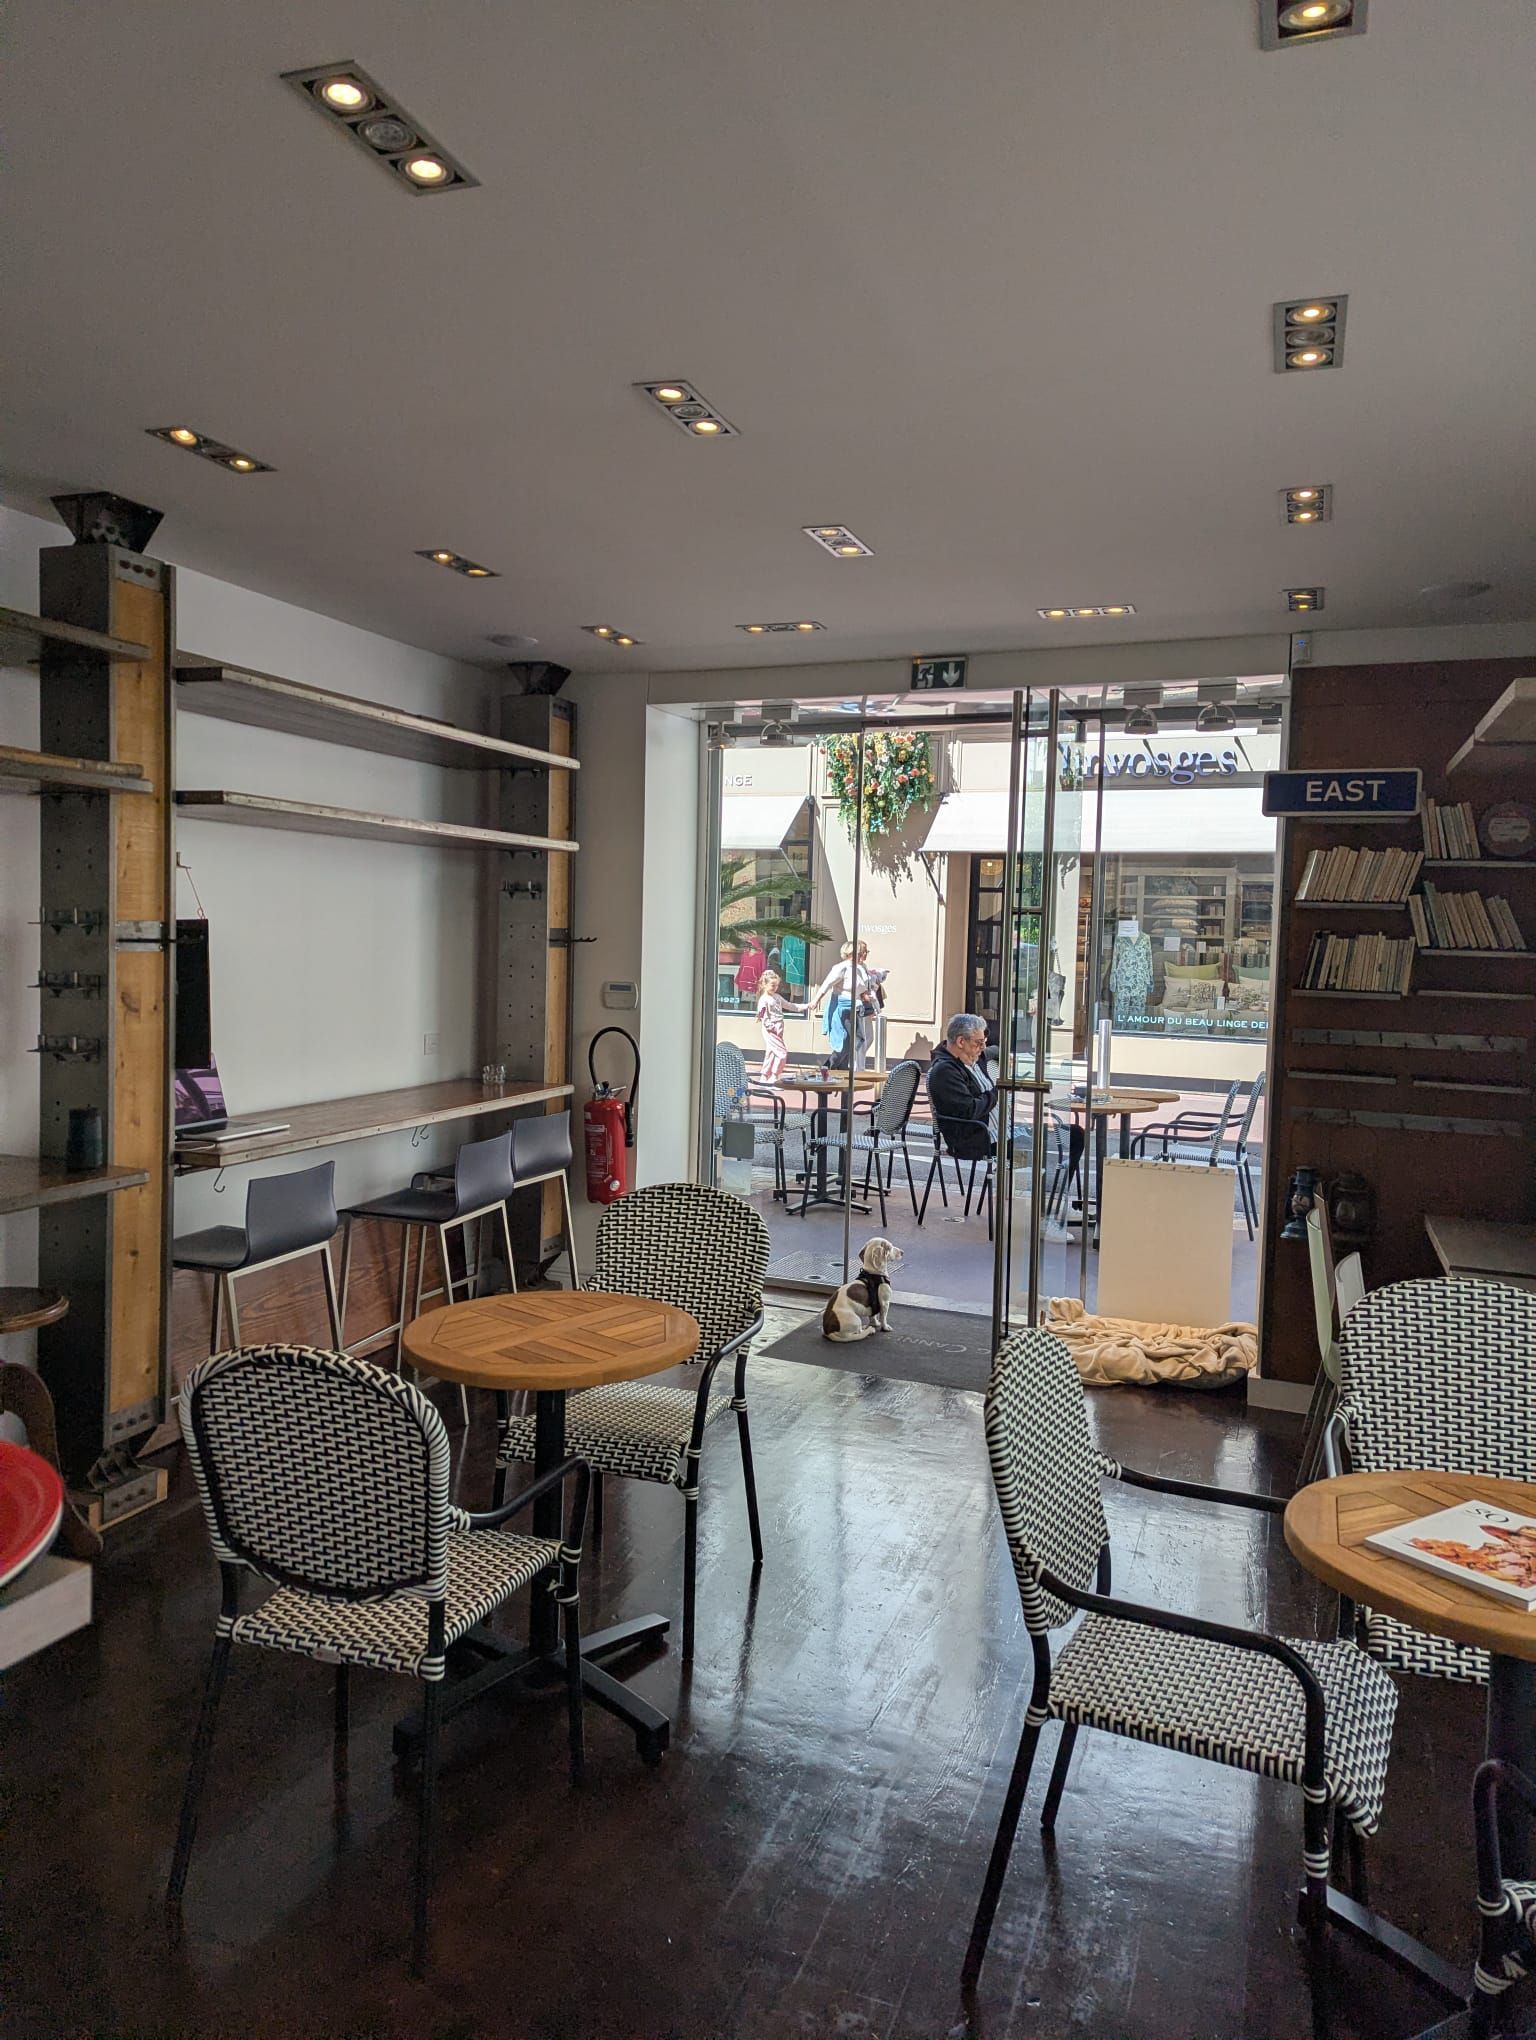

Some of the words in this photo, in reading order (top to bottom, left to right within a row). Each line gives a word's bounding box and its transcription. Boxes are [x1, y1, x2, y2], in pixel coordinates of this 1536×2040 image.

[1306, 779, 1386, 802] EAST
[1167, 1017, 1182, 1025] DU
[1185, 1017, 1213, 1027] BEAU
[1216, 1019, 1248, 1029] LINGE
